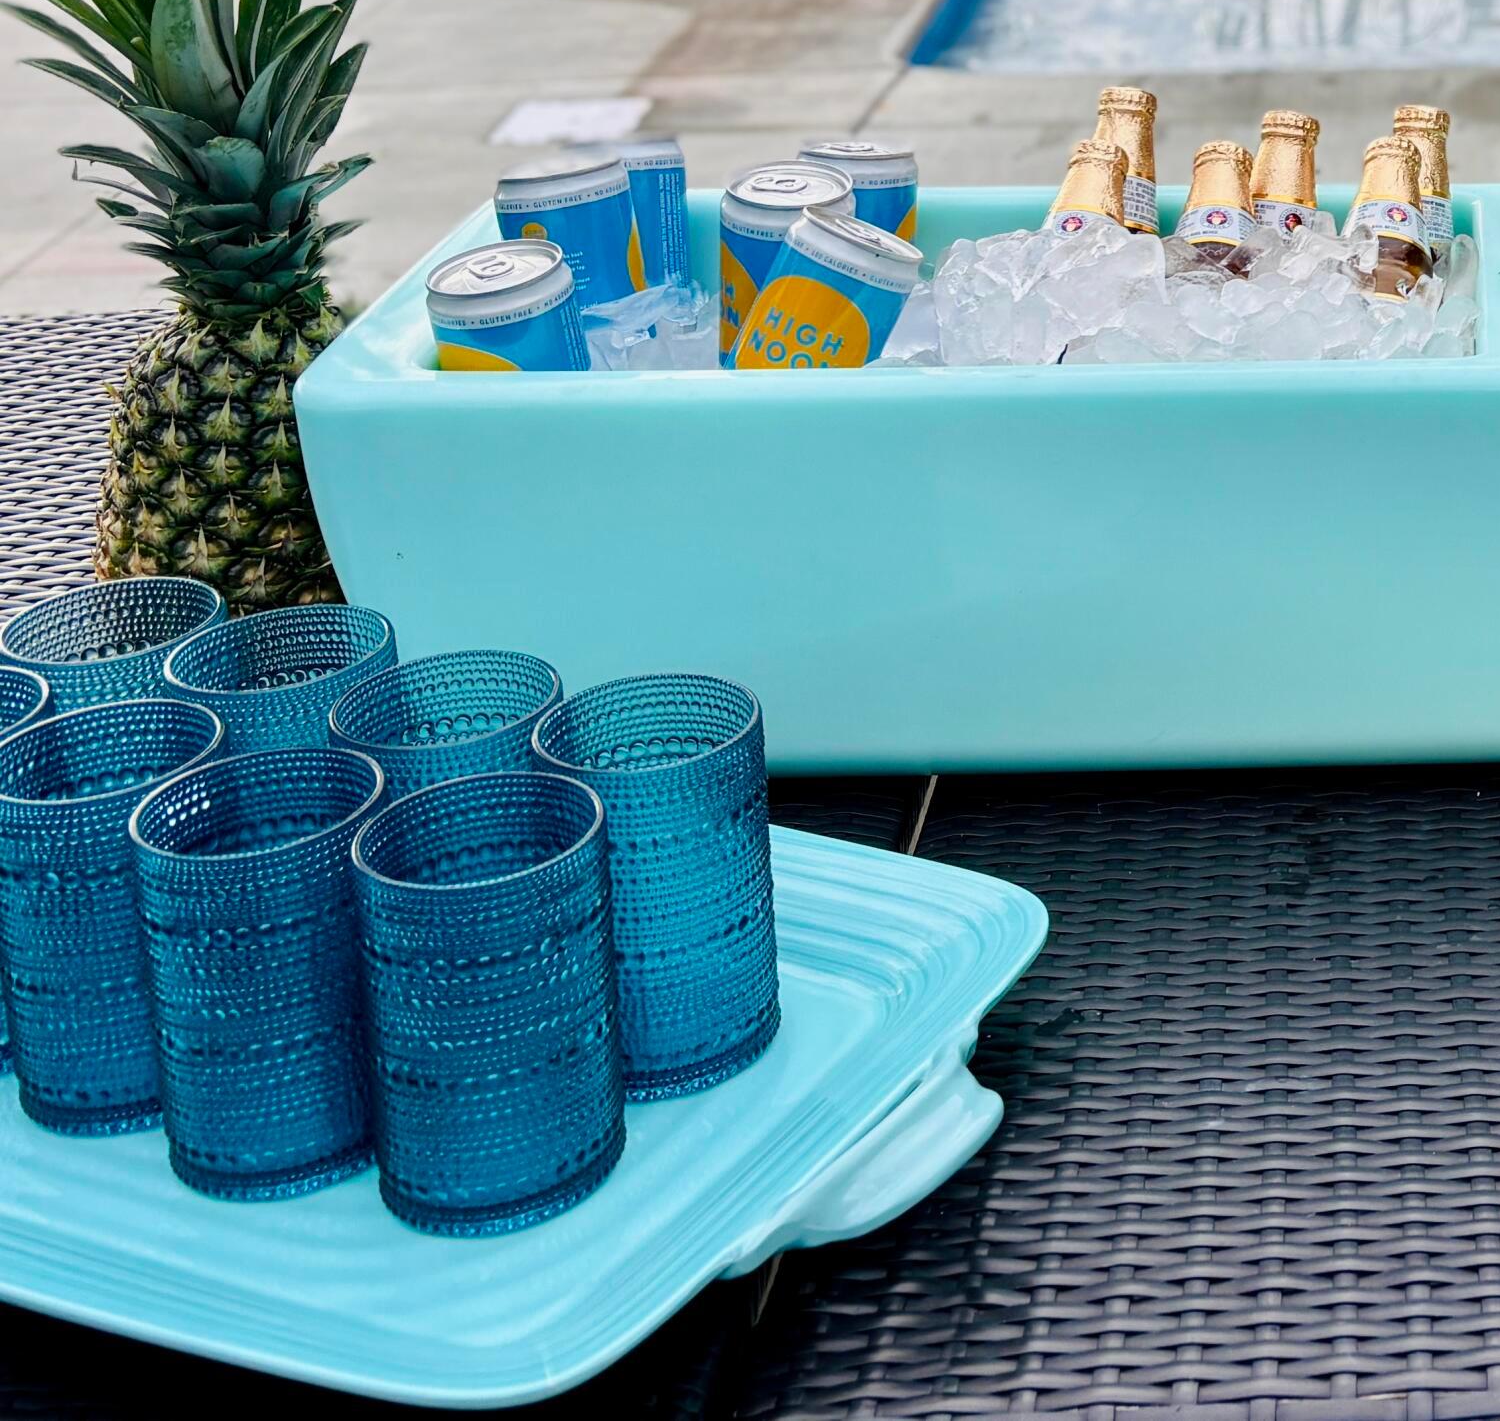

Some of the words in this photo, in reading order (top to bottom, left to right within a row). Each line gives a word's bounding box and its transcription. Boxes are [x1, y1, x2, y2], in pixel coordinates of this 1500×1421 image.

[534, 199, 562, 209] GLUTEN
[824, 257, 859, 276] CALORIES
[479, 314, 511, 326] GLUTEN
[764, 306, 844, 356] HIGH
